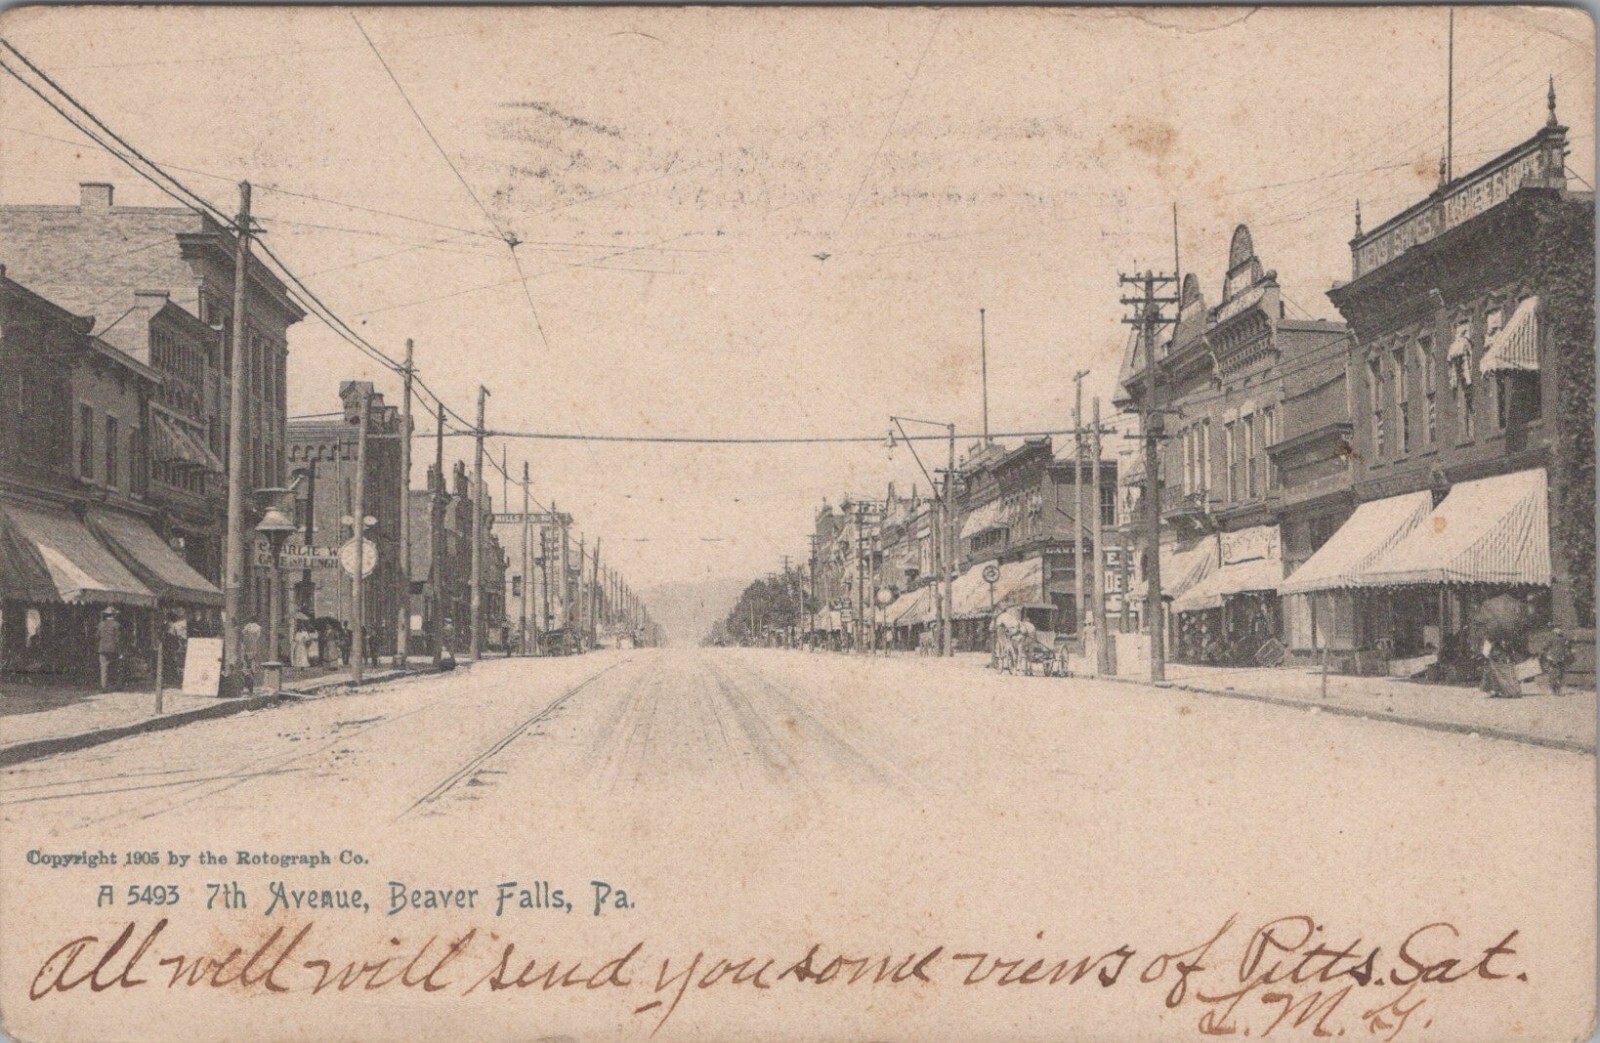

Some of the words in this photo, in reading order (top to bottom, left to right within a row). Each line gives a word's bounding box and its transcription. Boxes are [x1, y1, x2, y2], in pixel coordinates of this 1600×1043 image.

[258, 542, 320, 557] CARLIE
[258, 553, 288, 566] CAE
[158, 921, 314, 994] well
[302, 927, 478, 995] will
[462, 941, 644, 997] send
[653, 948, 775, 1039] you
[776, 943, 944, 986] some
[952, 930, 1137, 989] views
[1140, 912, 1239, 1009] of
